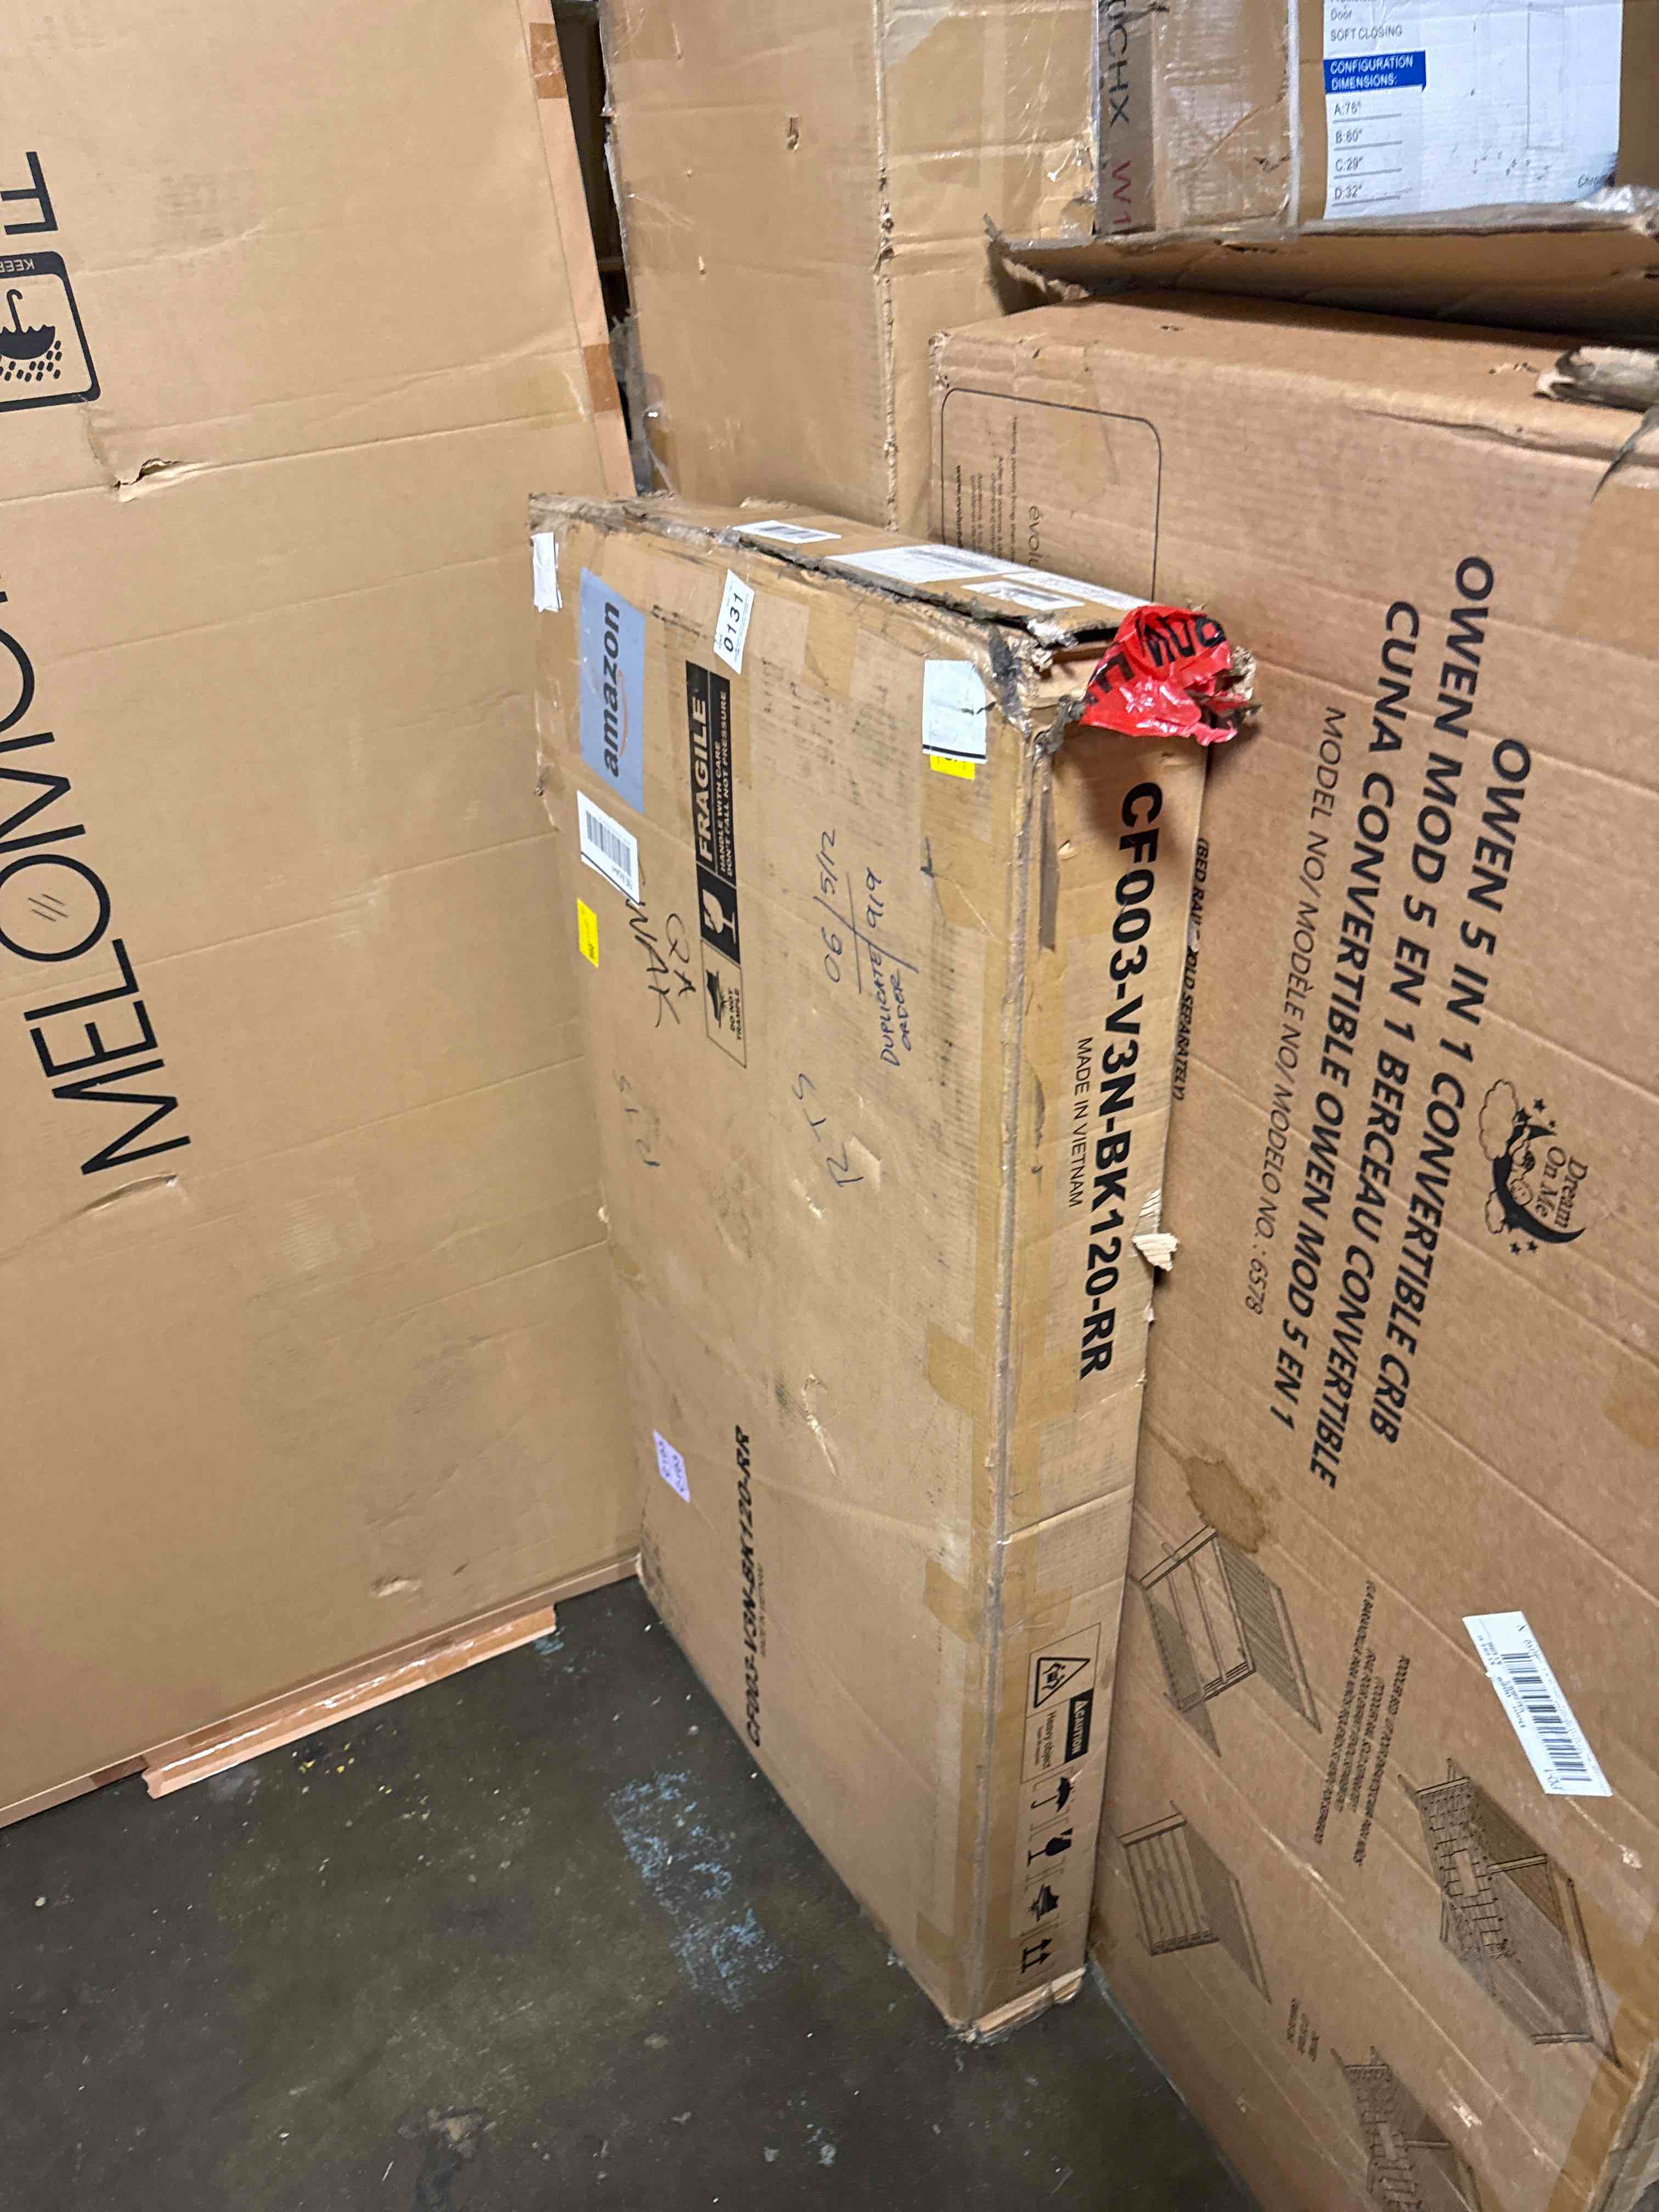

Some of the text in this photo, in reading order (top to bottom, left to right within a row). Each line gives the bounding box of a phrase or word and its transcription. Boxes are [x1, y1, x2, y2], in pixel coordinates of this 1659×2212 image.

[1330, 24, 1403, 42] SOFT CLOSING
[1330, 54, 1414, 75] CONFIGURATION
[723, 593, 745, 653] 0131
[603, 601, 620, 777] amazon
[720, 690, 729, 766] PRESSURE
[692, 696, 713, 863] FRAGILE
[1310, 706, 1346, 821] MODEL
[1301, 831, 1330, 900] NO/
[869, 941, 901, 1068] DUPLICATE
[1284, 900, 1318, 1022] MODÈLE
[892, 969, 913, 1052] ORDER
[1269, 601, 1420, 1431] CUNA CONVERTIBLE OWEN MOD 5 EN 1
[1277, 1023, 1303, 1085] NO/
[1310, 556, 1495, 1490] OWEN MOD 5 EN 1 BERCEAU CONVERTIBLE
[1068, 1036, 1093, 1207] MADE IN VIETNAM
[1079, 781, 1164, 1380] CF003-V3N-BK120-RR
[1370, 738, 1532, 1444] OWEN 5 IN 1 CONVERTIBLE CRIB
[1261, 1085, 1293, 1195] MODELO
[1534, 1145, 1568, 1220] On Me
[1556, 1157, 1589, 1228] Dream
[1244, 1256, 1268, 1316] 6578
[735, 1425, 761, 1747] CF003-V3N-BK120-RR
[1042, 1709, 1057, 1741] Heavy
[1071, 1709, 1087, 1755] CAUTION
